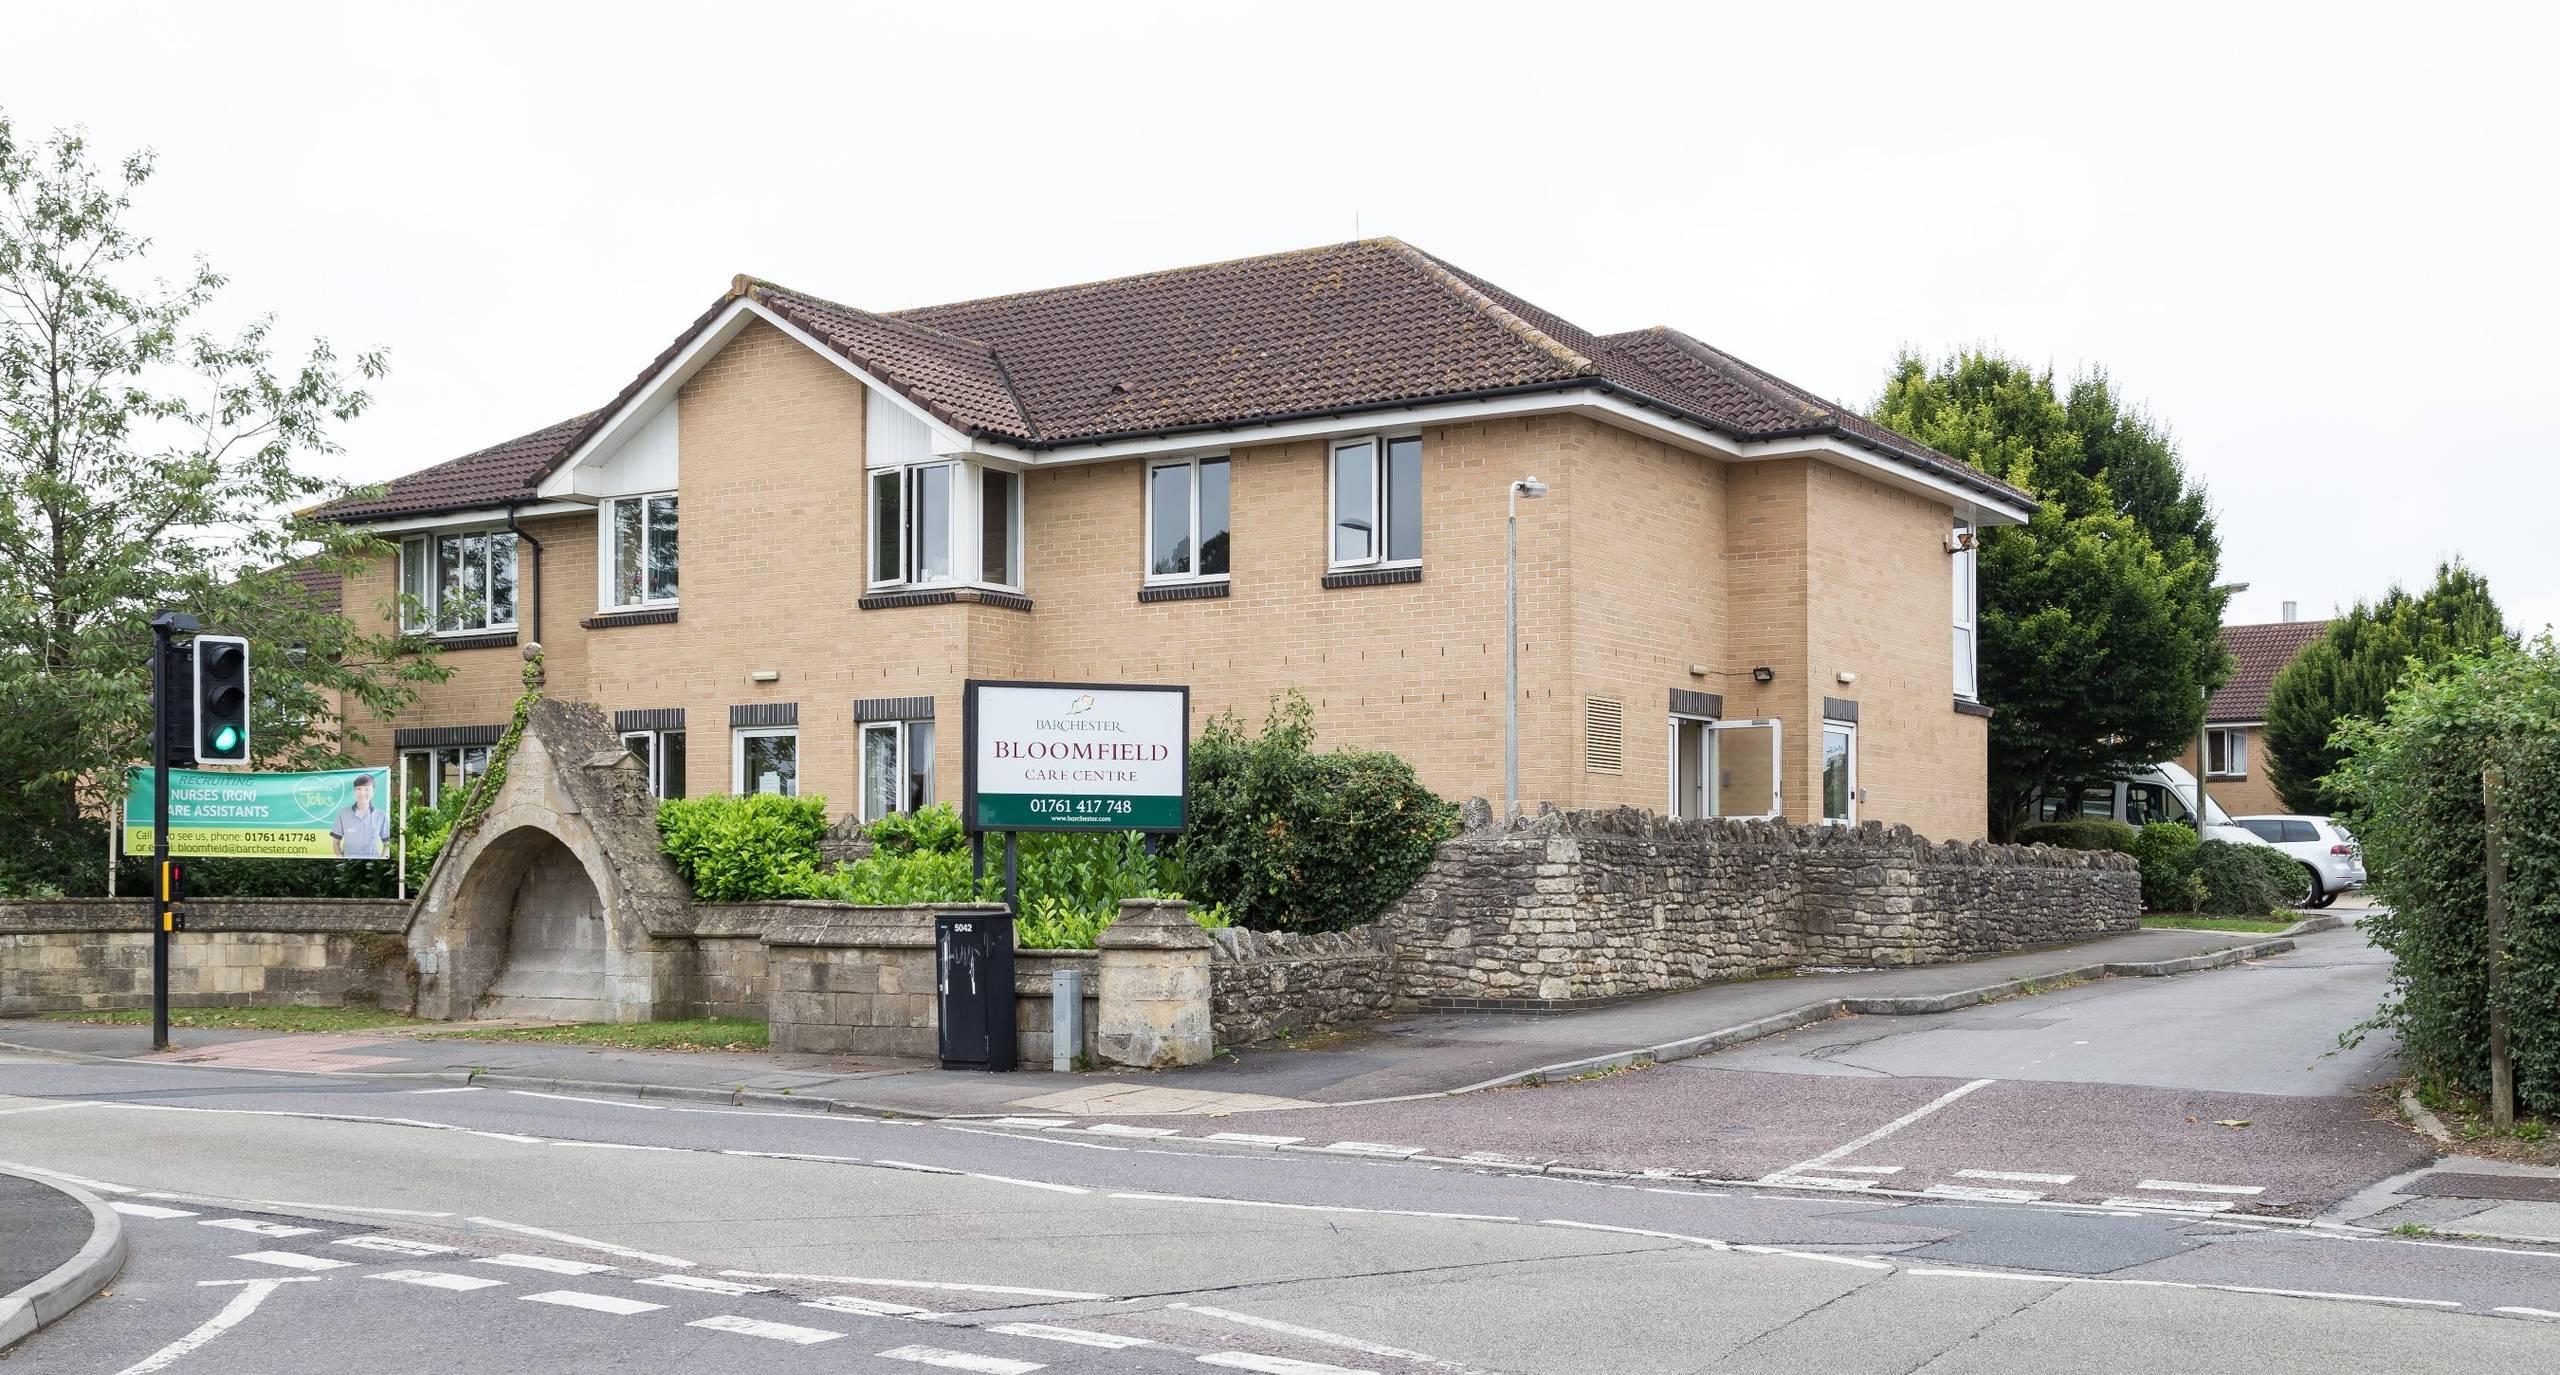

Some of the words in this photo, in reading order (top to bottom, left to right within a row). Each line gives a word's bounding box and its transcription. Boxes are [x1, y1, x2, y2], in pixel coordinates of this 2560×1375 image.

[1035, 719, 1125, 733] BARCHESTER
[993, 741, 1168, 761] BLOOMFIELD
[179, 775, 254, 787] RECRUITING
[1025, 769, 1069, 782] CARE
[1072, 769, 1138, 783] CENTRE
[171, 789, 218, 801] NURSES
[222, 789, 256, 802] (RGN)
[168, 805, 191, 816] ARE
[193, 805, 269, 818] ASSISTANTS
[1030, 799, 1071, 813] 01761
[1076, 799, 1101, 814] 417
[1107, 800, 1132, 814] 748
[1051, 815, 1112, 823] www.barchester.com
[136, 830, 153, 840] Call
[177, 832, 193, 841] see
[195, 832, 208, 842] us,
[210, 831, 242, 844] phone:
[244, 832, 275, 842] 01761
[278, 833, 317, 842] 417748
[136, 844, 147, 852] or
[178, 843, 307, 854] bloomfield@barchester.com
[954, 923, 973, 932] 5042
